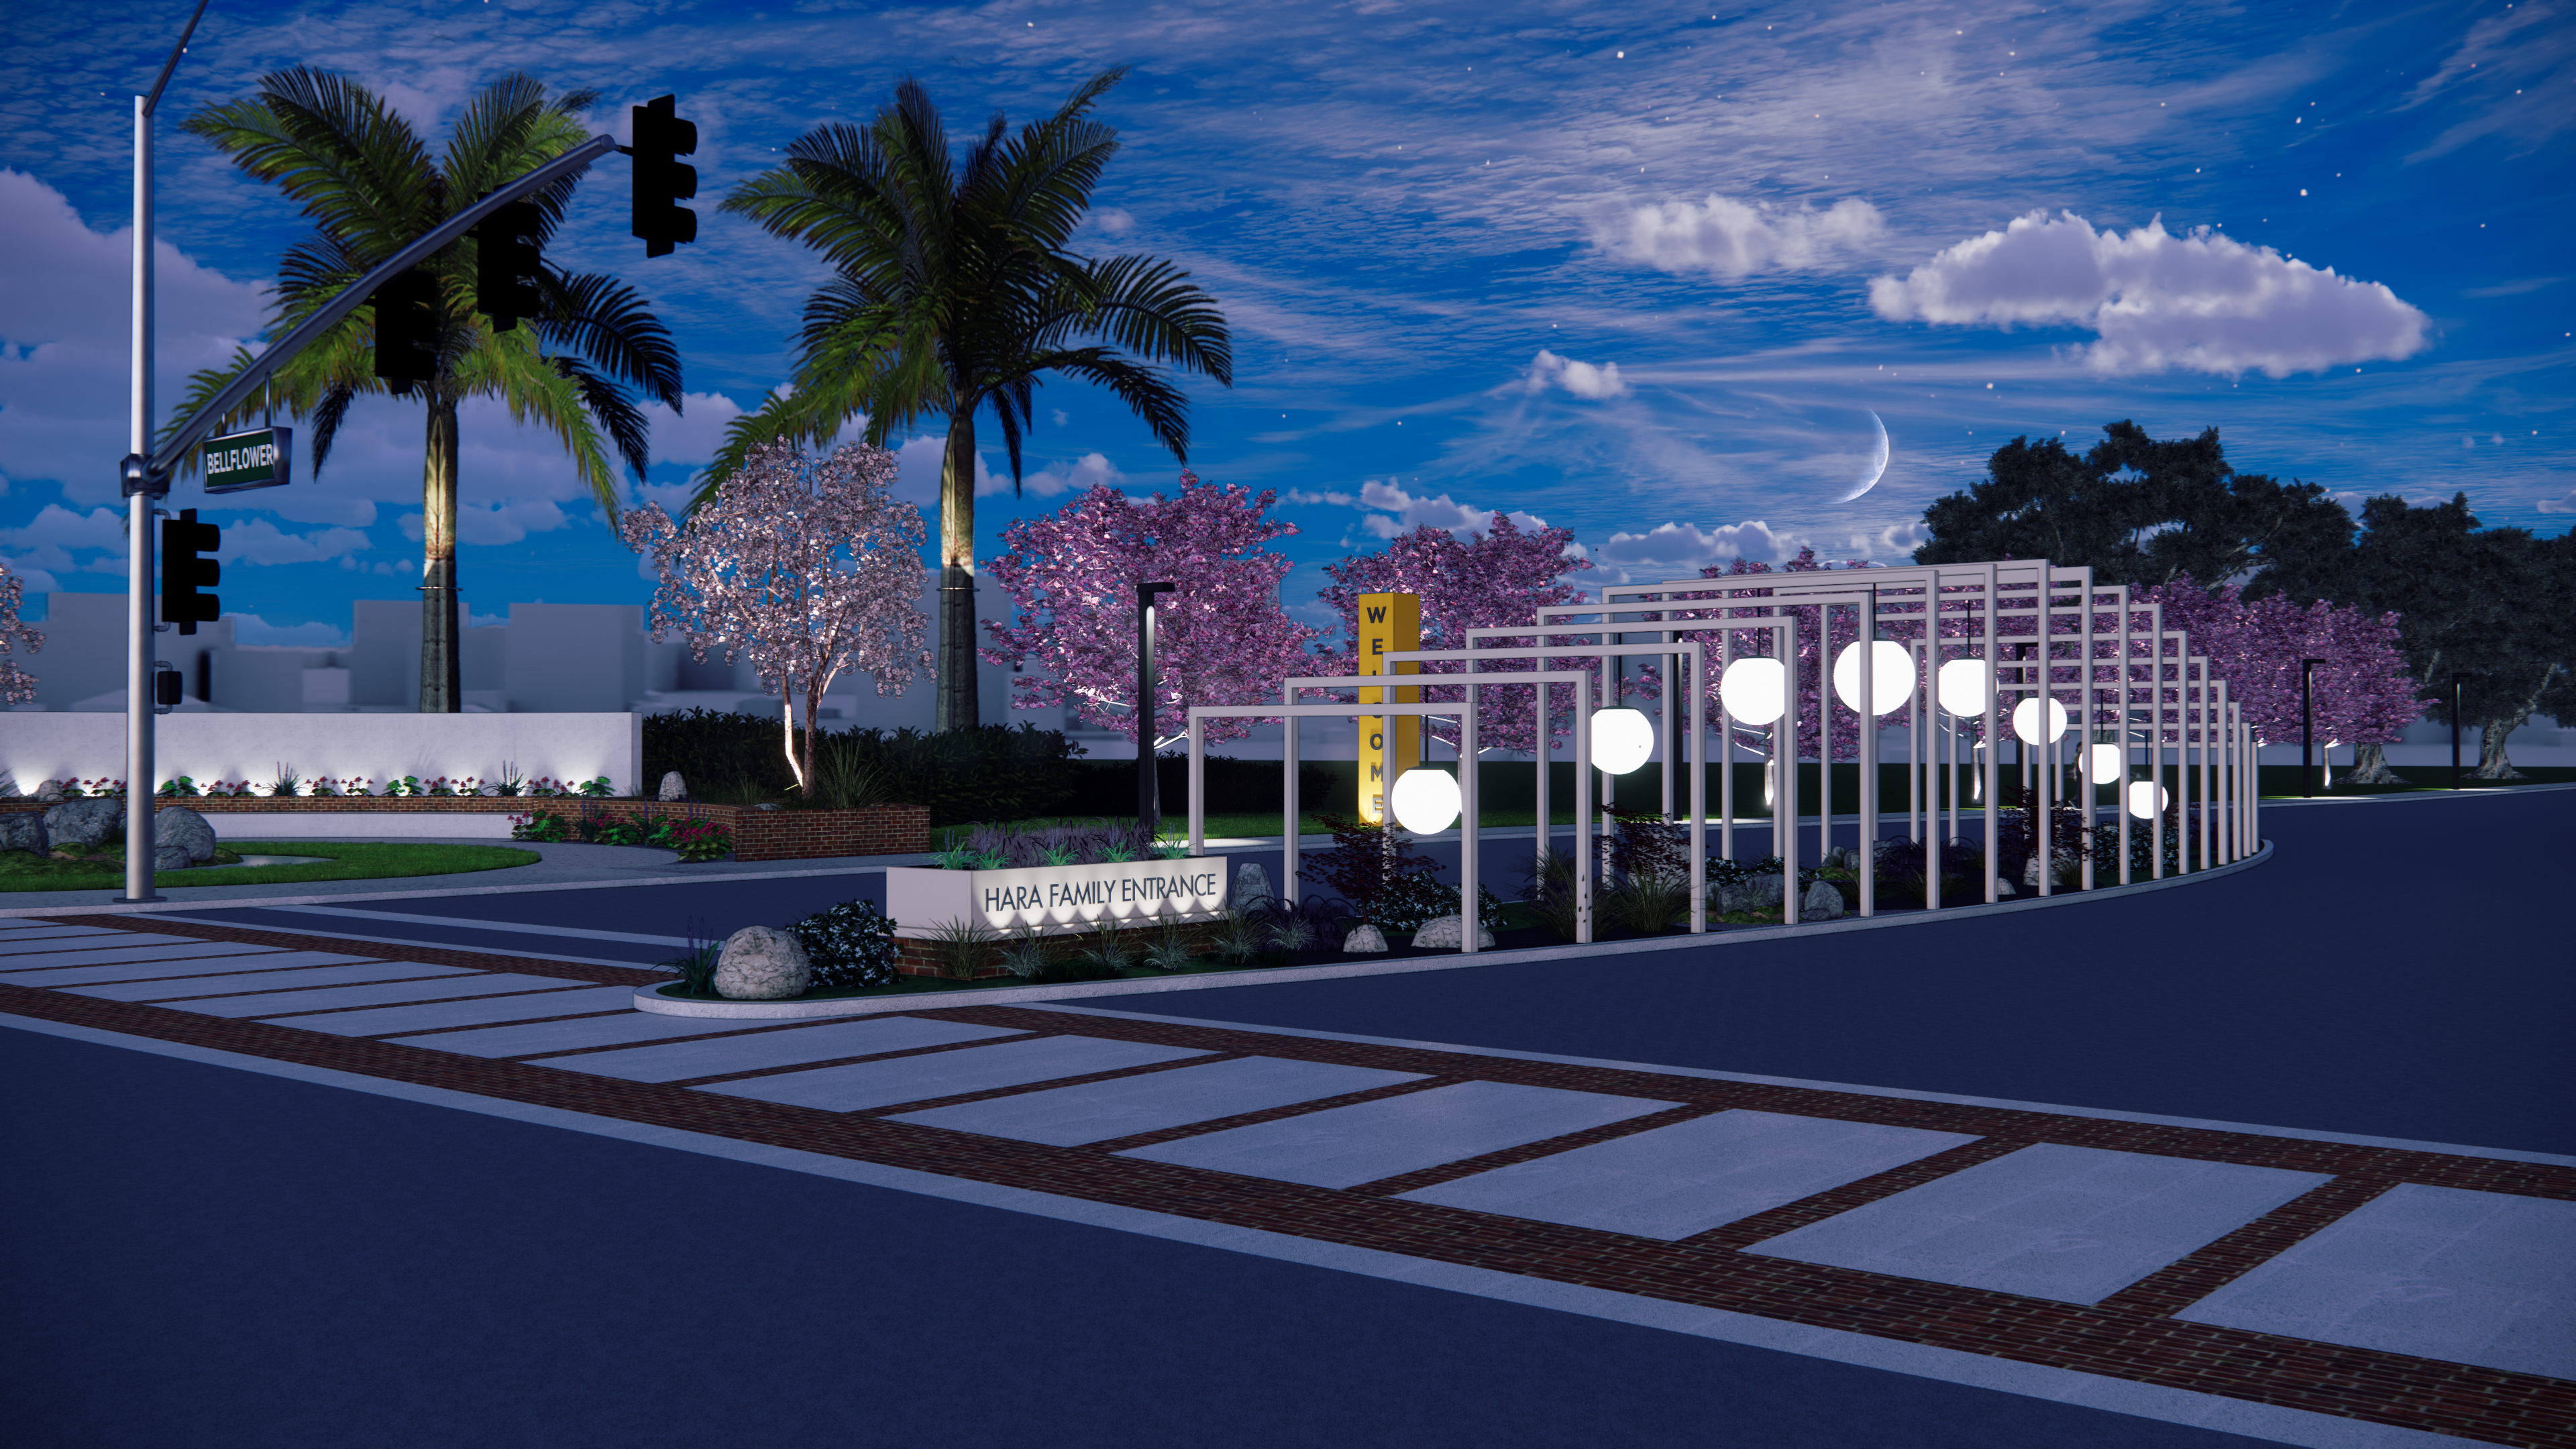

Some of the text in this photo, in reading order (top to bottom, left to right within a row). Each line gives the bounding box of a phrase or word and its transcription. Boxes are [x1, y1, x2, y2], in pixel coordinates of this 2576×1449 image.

[207, 443, 274, 474] BELLFLOWER
[1366, 606, 1387, 814] WEOME
[985, 873, 1216, 912] HARA FAMILY ENTRANCE
